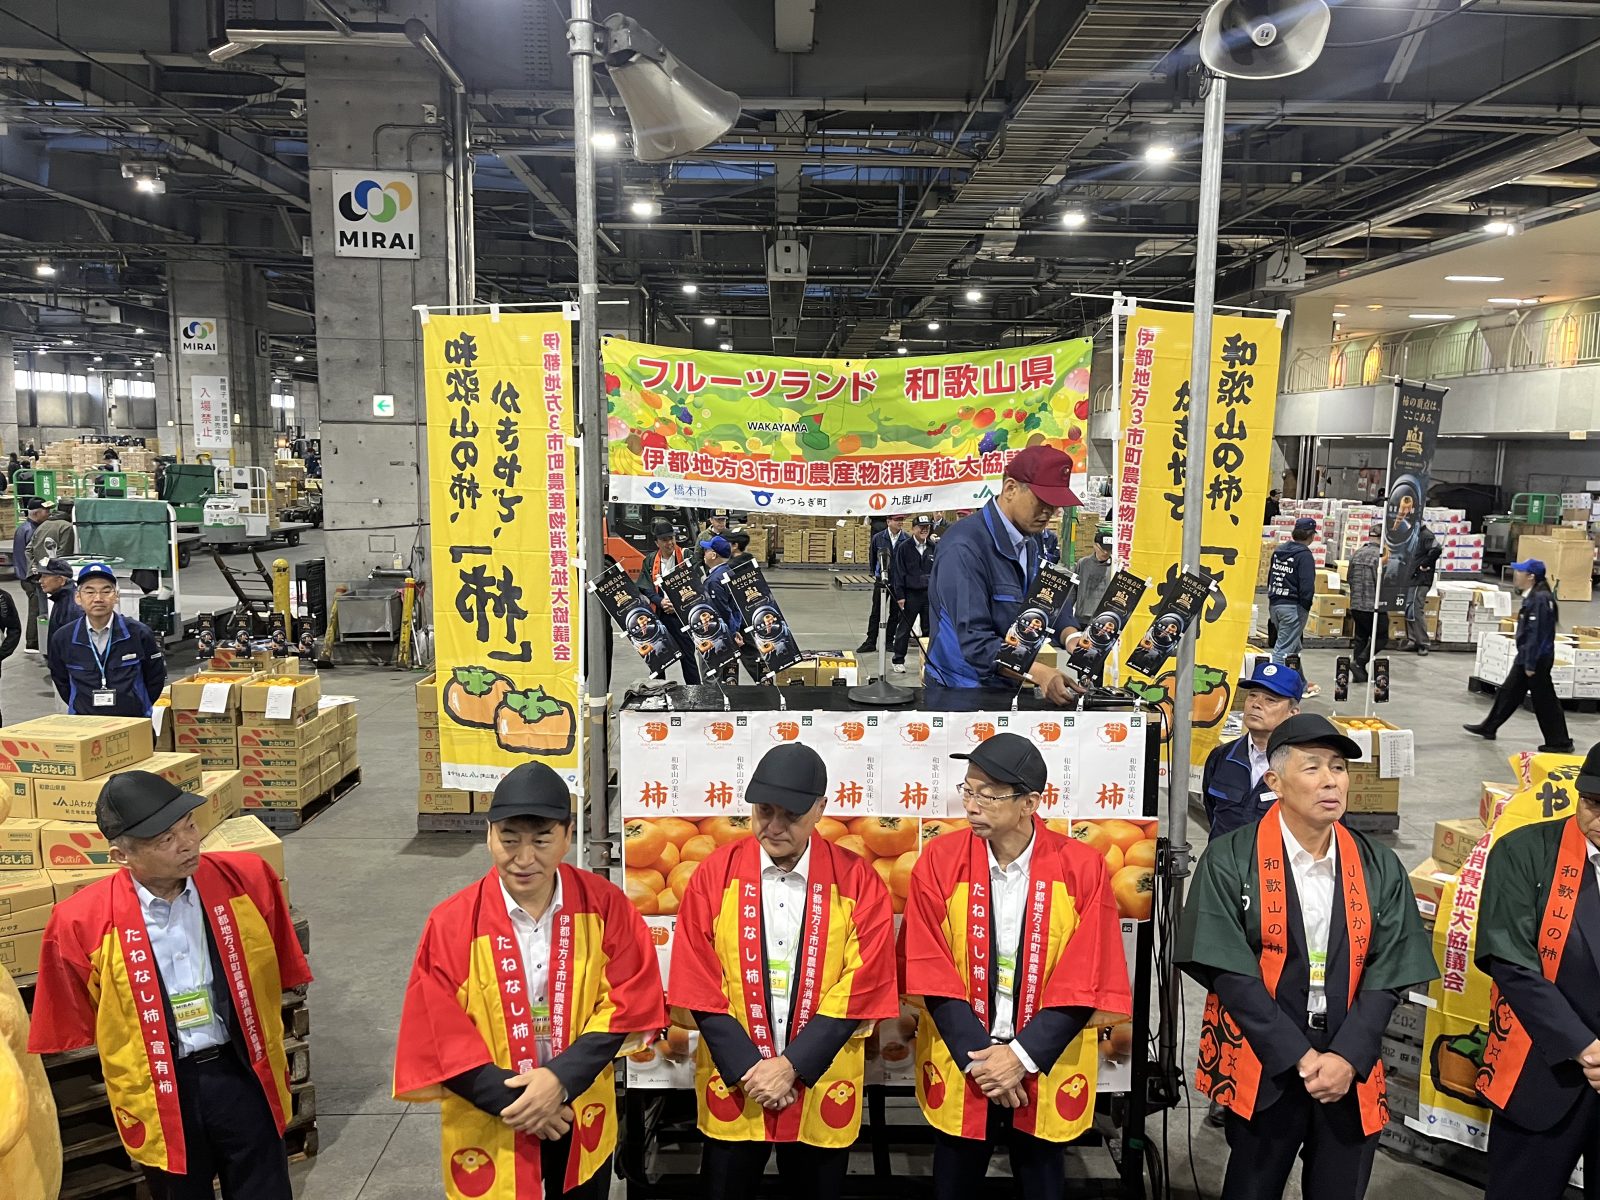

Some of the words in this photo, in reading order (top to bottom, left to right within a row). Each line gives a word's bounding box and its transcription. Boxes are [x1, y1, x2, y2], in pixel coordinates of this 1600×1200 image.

[339, 230, 414, 250] MIRAI
[183, 343, 216, 351] MIRAI
[637, 357, 877, 403] フルーツランド
[905, 354, 1056, 402] 和歌山県
[200, 387, 212, 438] 入場禁止
[747, 421, 809, 434] WAKAYAMA
[674, 483, 708, 497] 橋本市
[777, 496, 827, 508] かつらぎ町
[890, 492, 933, 506] 九度山町
[31, 763, 75, 776] たねなし柿
[69, 800, 96, 809] JAわか
[639, 781, 669, 810] 柿
[704, 781, 734, 810] 柿
[834, 781, 864, 810] 柿
[898, 781, 929, 810] 柿
[1095, 782, 1126, 811] 柿
[1263, 857, 1283, 955] 和歌山の柿
[1347, 864, 1367, 968] JAわかやま
[1540, 864, 1579, 961] 和歌山の柿
[796, 883, 823, 1036] 伊都地方3市町農産物消費拡大
[1023, 880, 1046, 1029] 伊都地方3市町農産物消費拡大
[124, 927, 173, 1094] たねなし柿・富有柿
